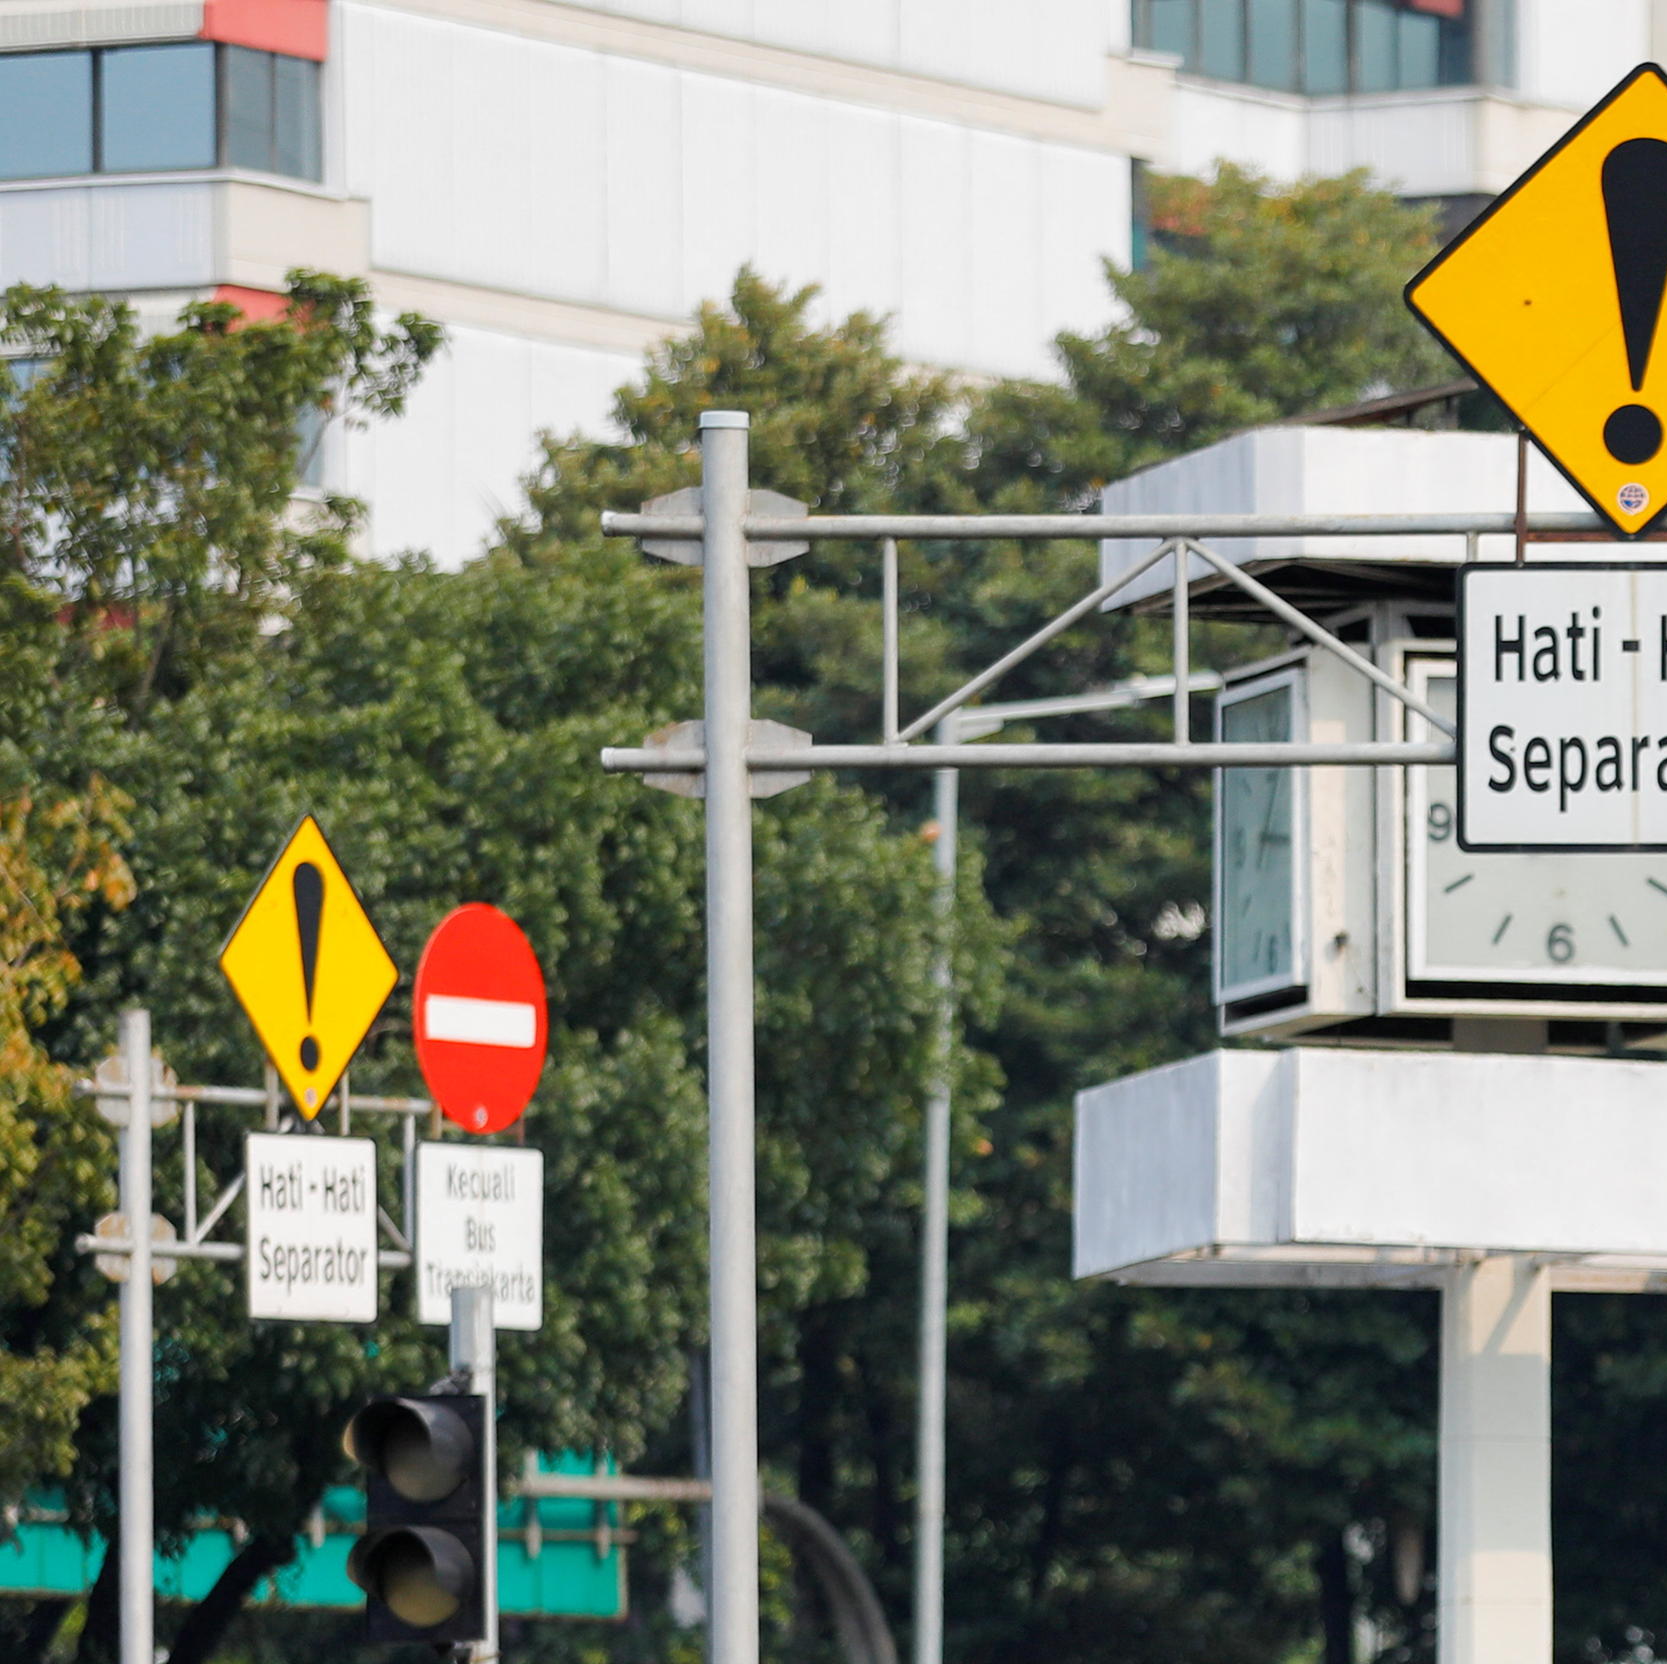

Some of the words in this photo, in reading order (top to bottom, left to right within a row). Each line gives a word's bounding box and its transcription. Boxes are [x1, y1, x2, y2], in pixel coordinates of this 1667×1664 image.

[1495, 605, 1601, 682] Hati
[1427, 802, 1454, 842] 9
[1547, 923, 1576, 963] 6
[260, 1162, 304, 1210] Hati
[323, 1165, 365, 1212] Hati
[446, 1162, 516, 1201] Kecuali
[465, 1217, 496, 1250] Bus
[259, 1235, 368, 1296] Separator
